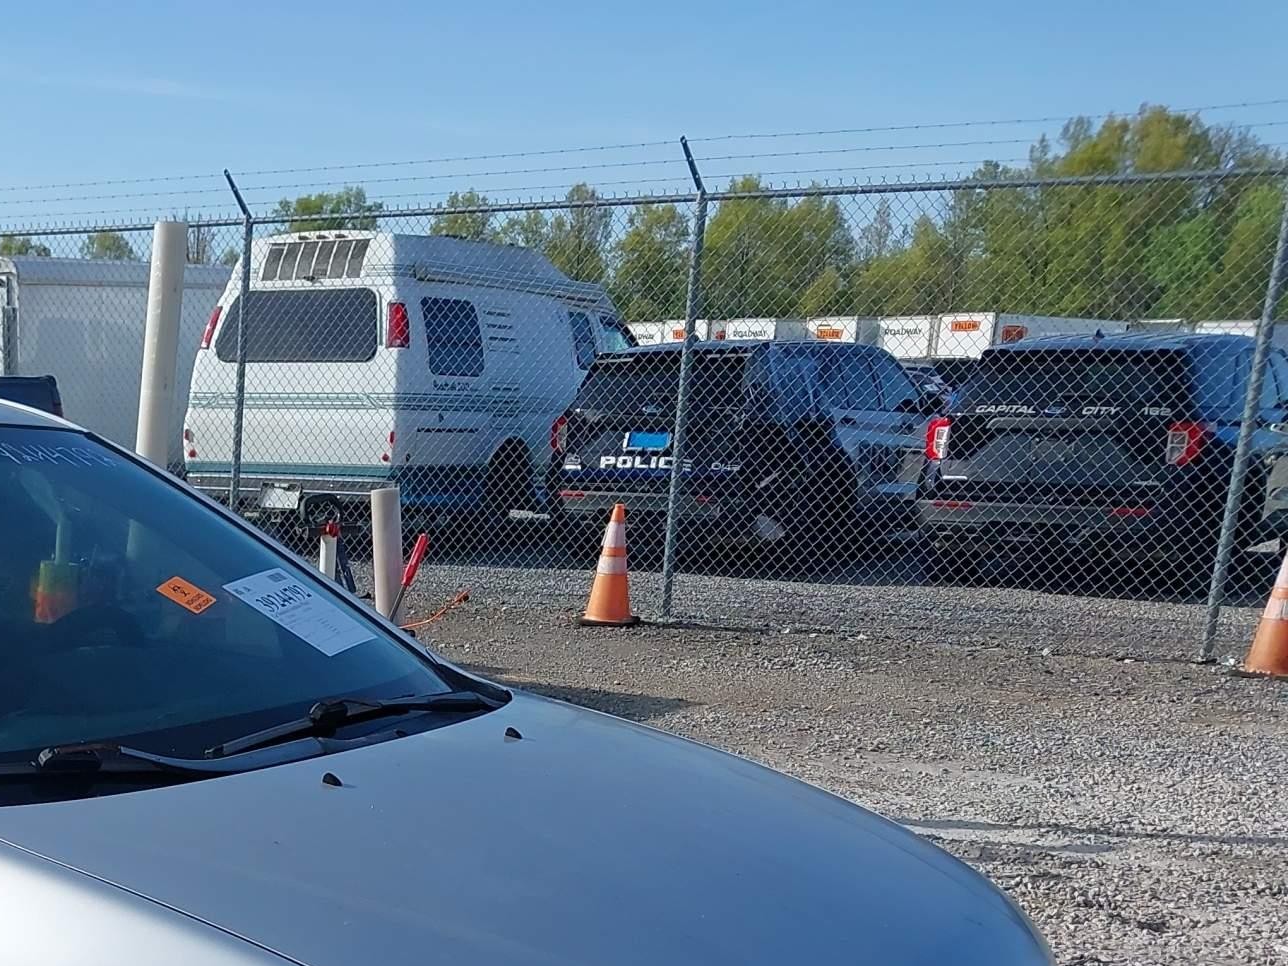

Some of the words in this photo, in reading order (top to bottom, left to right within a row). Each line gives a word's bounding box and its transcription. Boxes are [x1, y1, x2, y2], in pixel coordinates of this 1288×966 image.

[733, 330, 766, 338] ROADWAY
[975, 404, 1036, 414] CAPITAL
[1082, 405, 1121, 415] CITY
[599, 454, 693, 472] POLICE
[255, 584, 312, 613] 39244792
